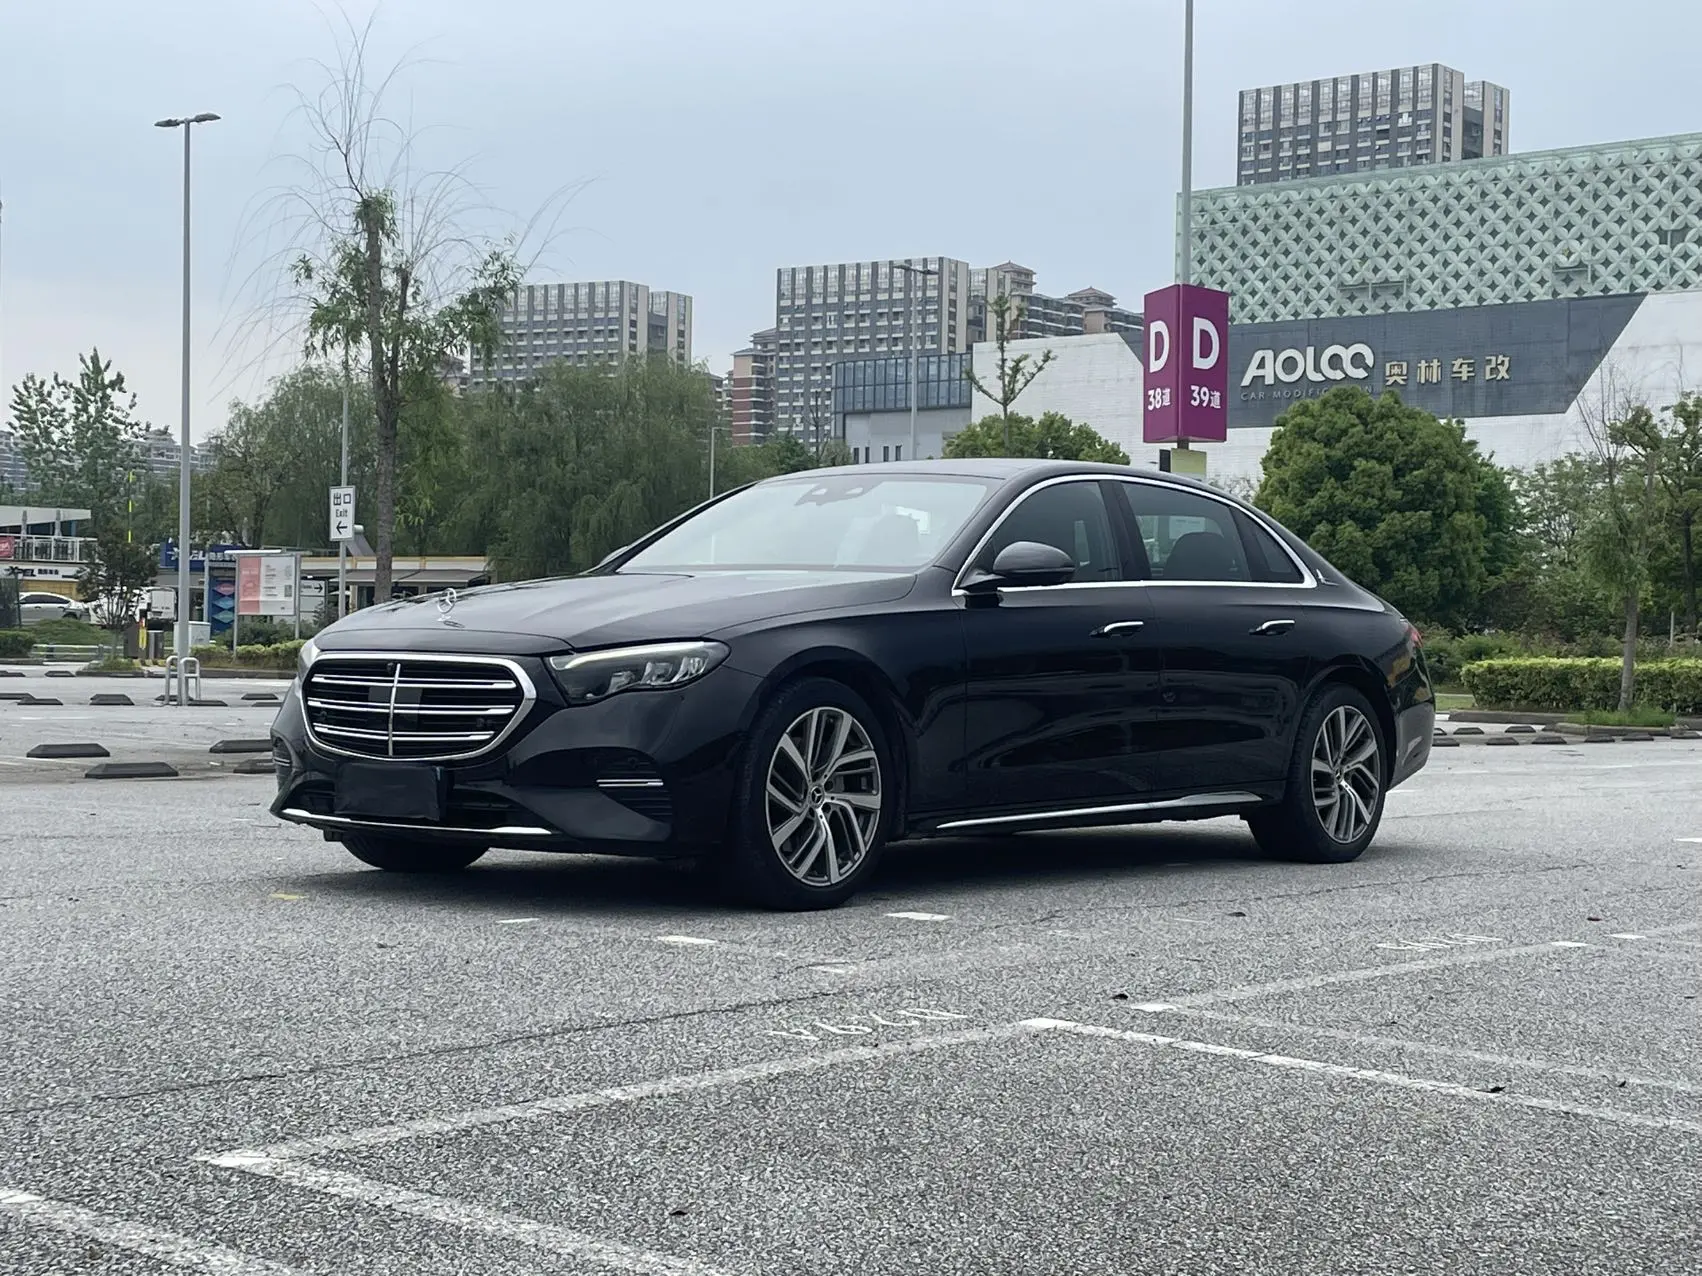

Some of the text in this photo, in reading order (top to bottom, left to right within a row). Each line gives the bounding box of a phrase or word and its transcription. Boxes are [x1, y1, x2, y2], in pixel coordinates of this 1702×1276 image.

[1150, 320, 1170, 373] D
[1193, 316, 1220, 370] D
[1385, 354, 1510, 386] 奥林车改
[1147, 387, 1171, 411] 38道
[1190, 384, 1221, 409] 39道
[1240, 391, 1265, 401] CAR
[333, 492, 352, 506] 出口
[335, 508, 349, 518] Exit
